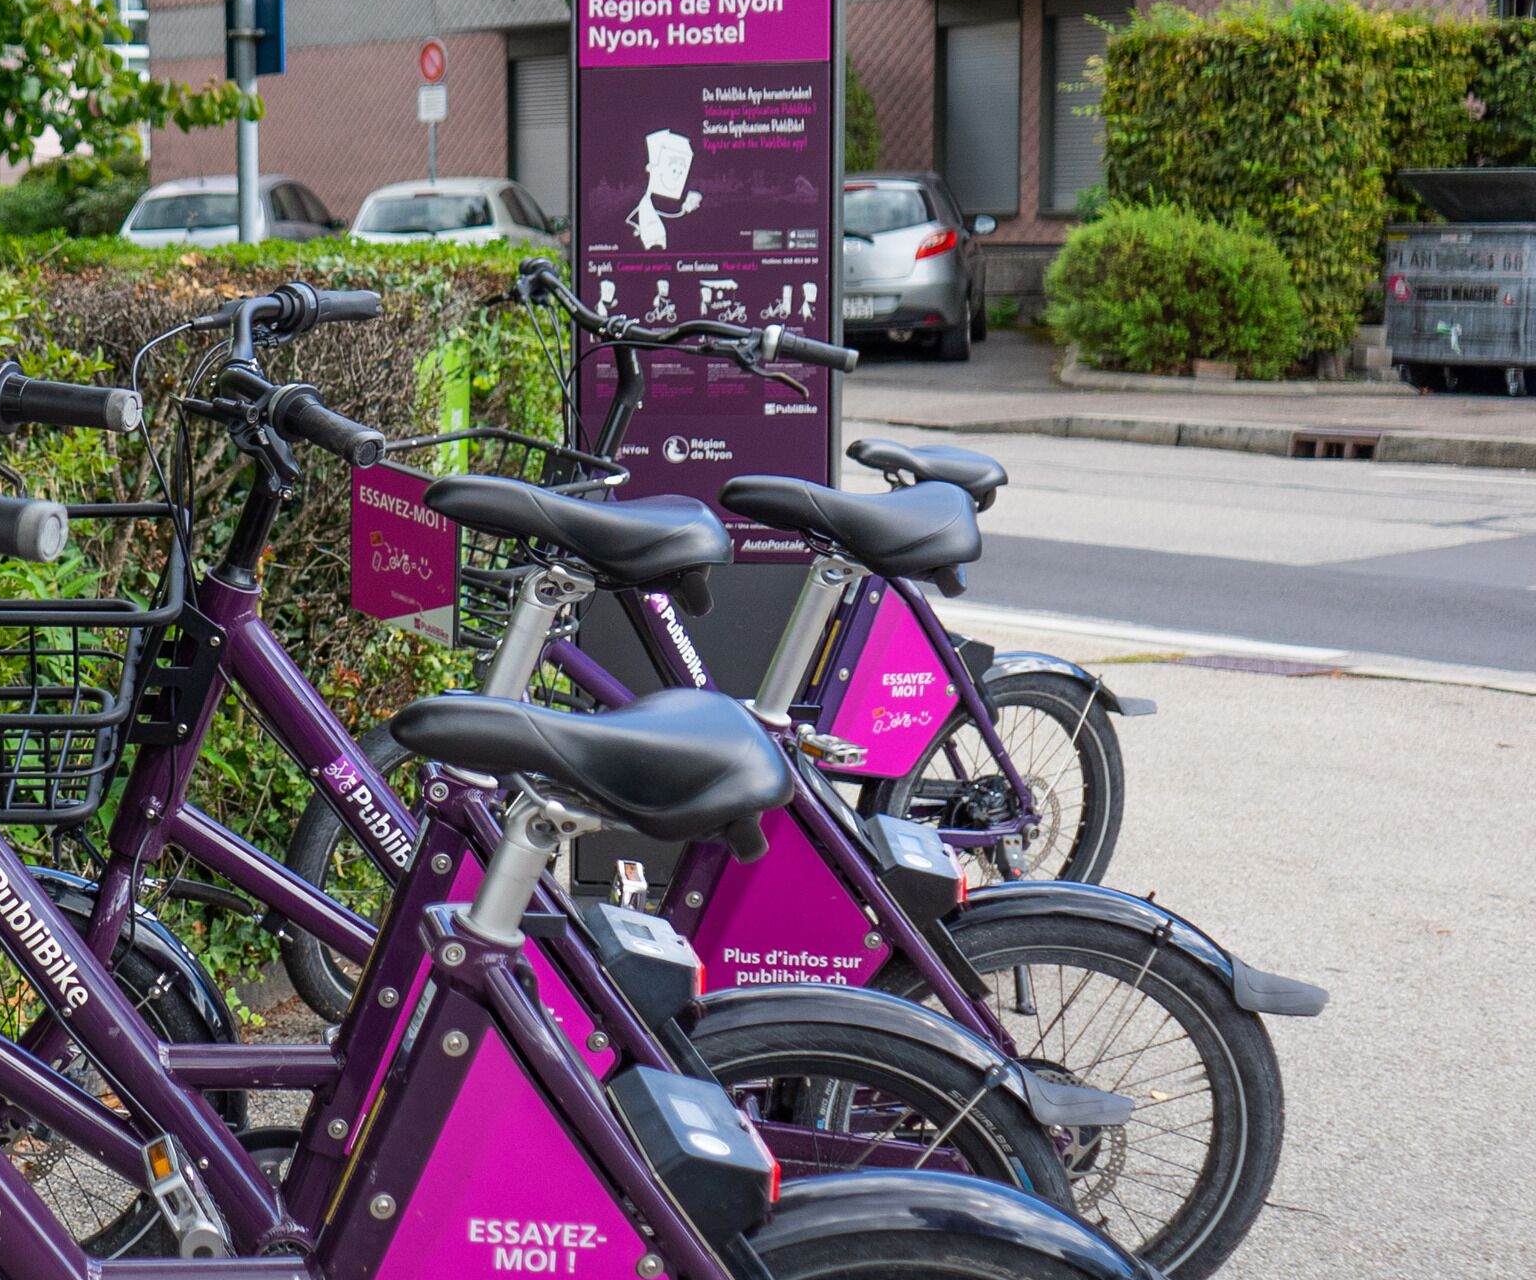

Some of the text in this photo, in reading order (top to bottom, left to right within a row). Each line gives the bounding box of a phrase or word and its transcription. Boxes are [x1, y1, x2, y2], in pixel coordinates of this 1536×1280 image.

[588, 20, 746, 53] Nyon, Hostel
[748, 86, 762, 105] App
[776, 403, 818, 415] PubliBike
[622, 446, 649, 455] NYON
[690, 438, 726, 451] Région
[690, 450, 733, 462] de Nyon
[359, 484, 440, 531] ESSAYEZ-MOI
[742, 538, 805, 551] AutoPostale
[660, 605, 707, 688] PubliBike
[882, 672, 936, 686] ESSAYEZ-
[891, 685, 917, 698] MOI
[724, 948, 863, 969] Plus d'infos sur
[736, 968, 847, 986] publibikech
[469, 1218, 608, 1249] ESSAYEZ-
[494, 1246, 576, 1275] MOI !
